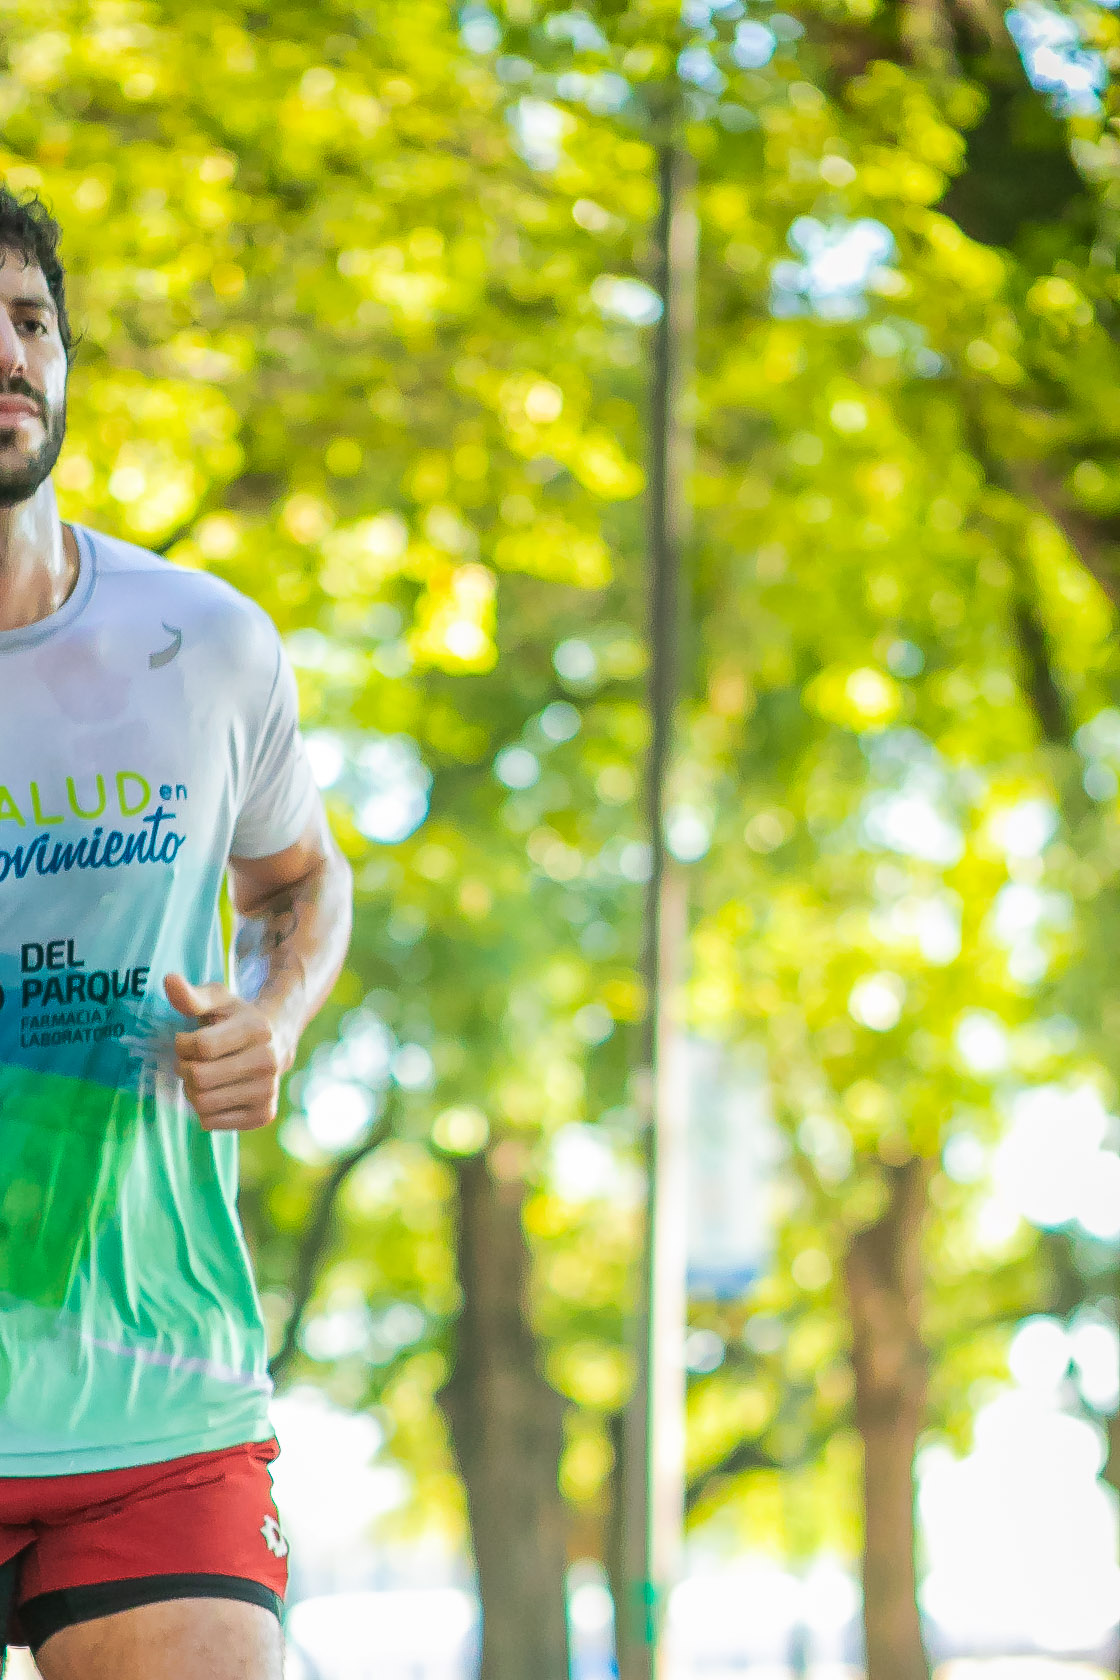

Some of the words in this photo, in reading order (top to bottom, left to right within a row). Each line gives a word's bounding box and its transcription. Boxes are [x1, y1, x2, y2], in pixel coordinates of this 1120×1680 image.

[159, 783, 188, 801] en
[20, 939, 85, 974] DEL
[21, 966, 151, 1009] PARQUE
[20, 1008, 102, 1030] FARMACIA
